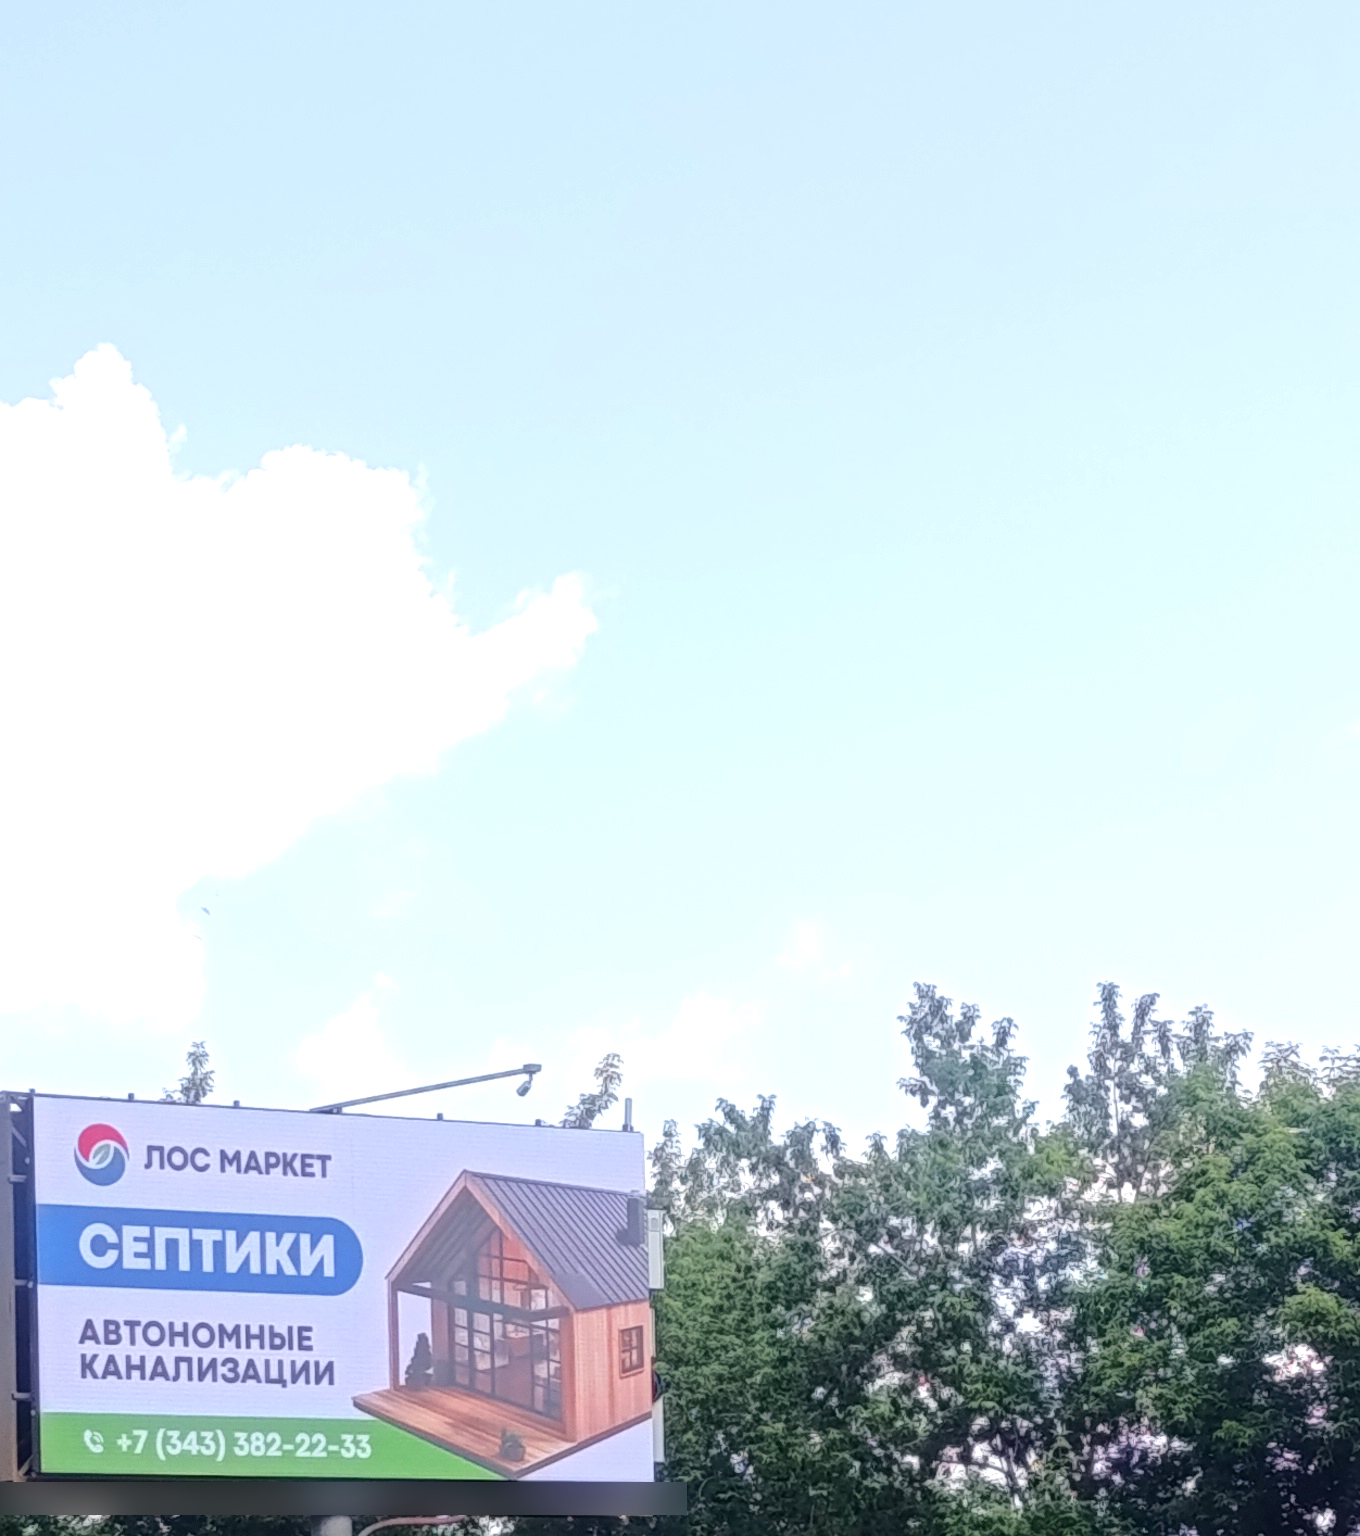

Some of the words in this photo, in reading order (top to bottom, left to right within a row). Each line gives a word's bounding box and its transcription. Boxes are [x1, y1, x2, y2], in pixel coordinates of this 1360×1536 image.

[144, 1145, 211, 1172] ЛОС
[219, 1149, 332, 1178] МАРКЕТ
[78, 1222, 336, 1278] СЕПТИКИ
[78, 1318, 314, 1351] АВТОНОМНЫЕ
[80, 1353, 335, 1388] КАНАЛИЗАЦИИ
[116, 1429, 148, 1453] +7
[156, 1428, 226, 1462] (343)
[234, 1431, 372, 1459] 382-22-33
